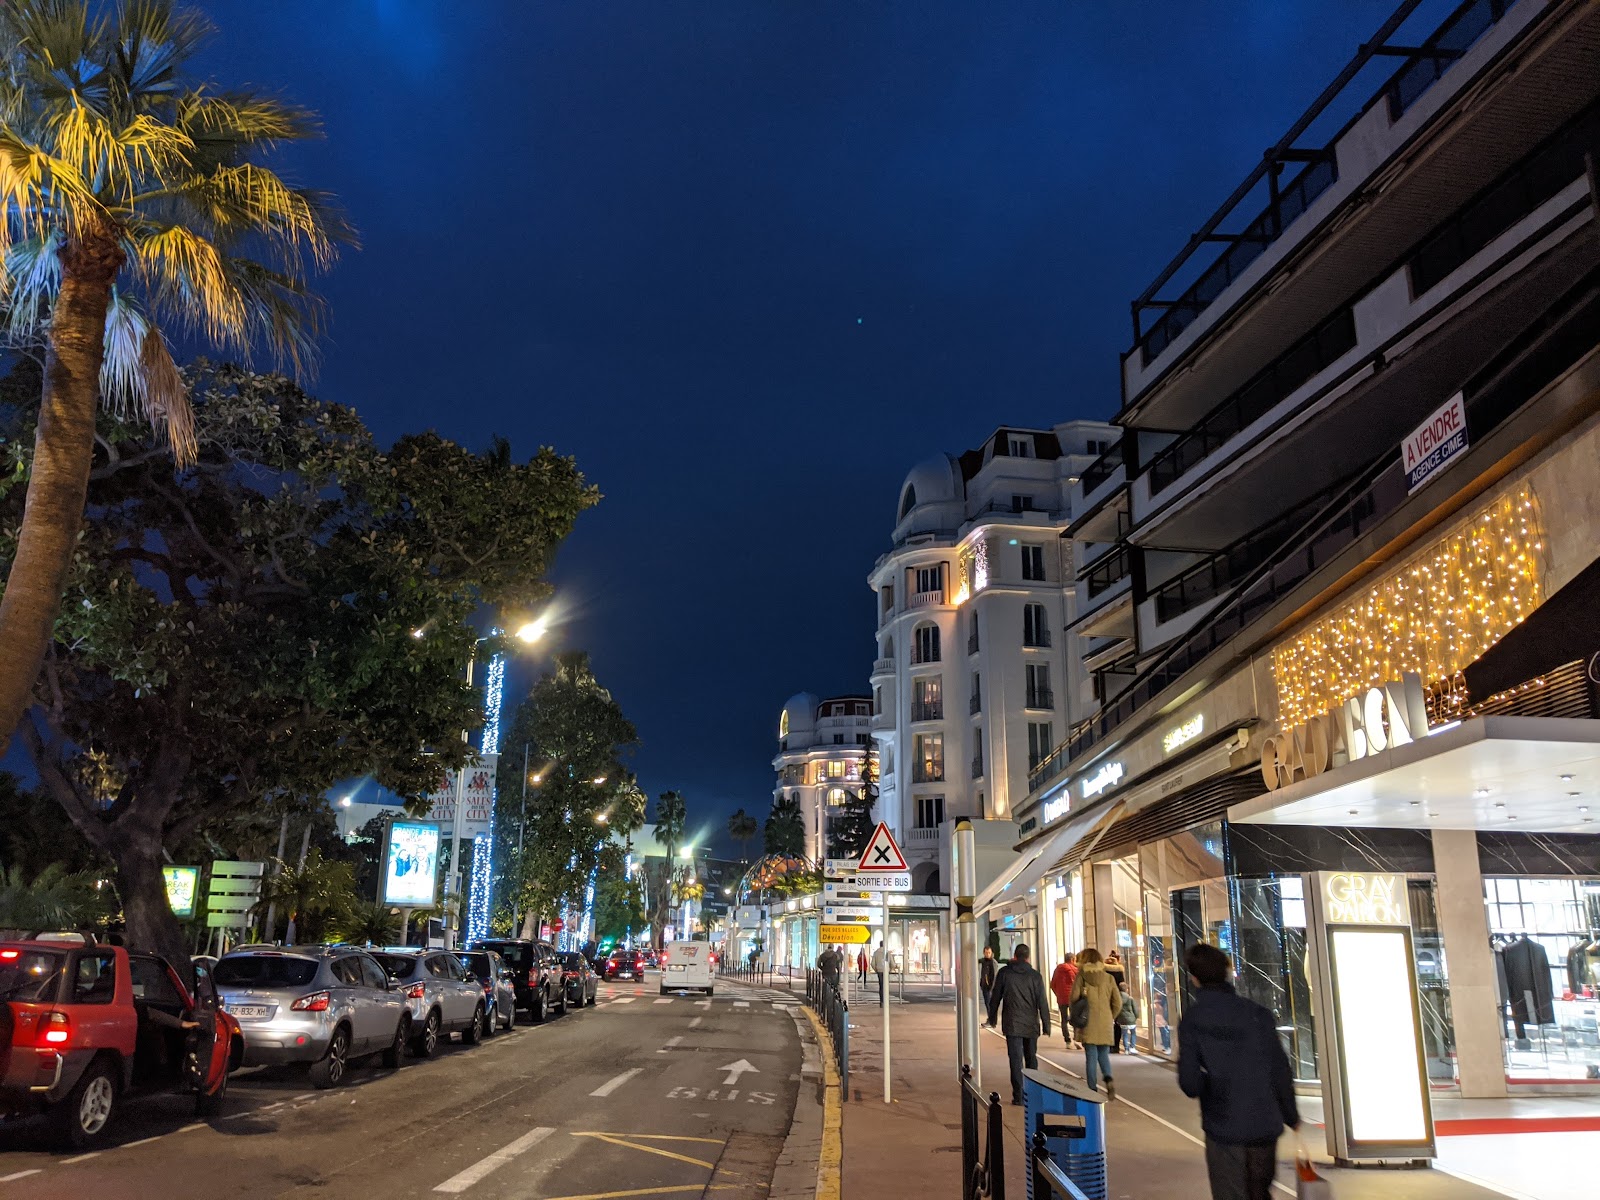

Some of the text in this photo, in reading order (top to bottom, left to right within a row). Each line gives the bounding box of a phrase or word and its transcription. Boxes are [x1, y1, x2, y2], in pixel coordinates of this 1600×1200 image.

[1407, 402, 1460, 467] A VENDRE
[1411, 432, 1464, 485] AGENCE CIME
[466, 797, 491, 805] SALES
[431, 810, 453, 819] CITY
[466, 810, 488, 818] CITY
[165, 880, 189, 888] REAK
[857, 877, 909, 887] SORTIE DE BUS
[1326, 873, 1396, 905] GRAY
[822, 933, 854, 941] Déviation
[665, 1086, 778, 1105] BUS
